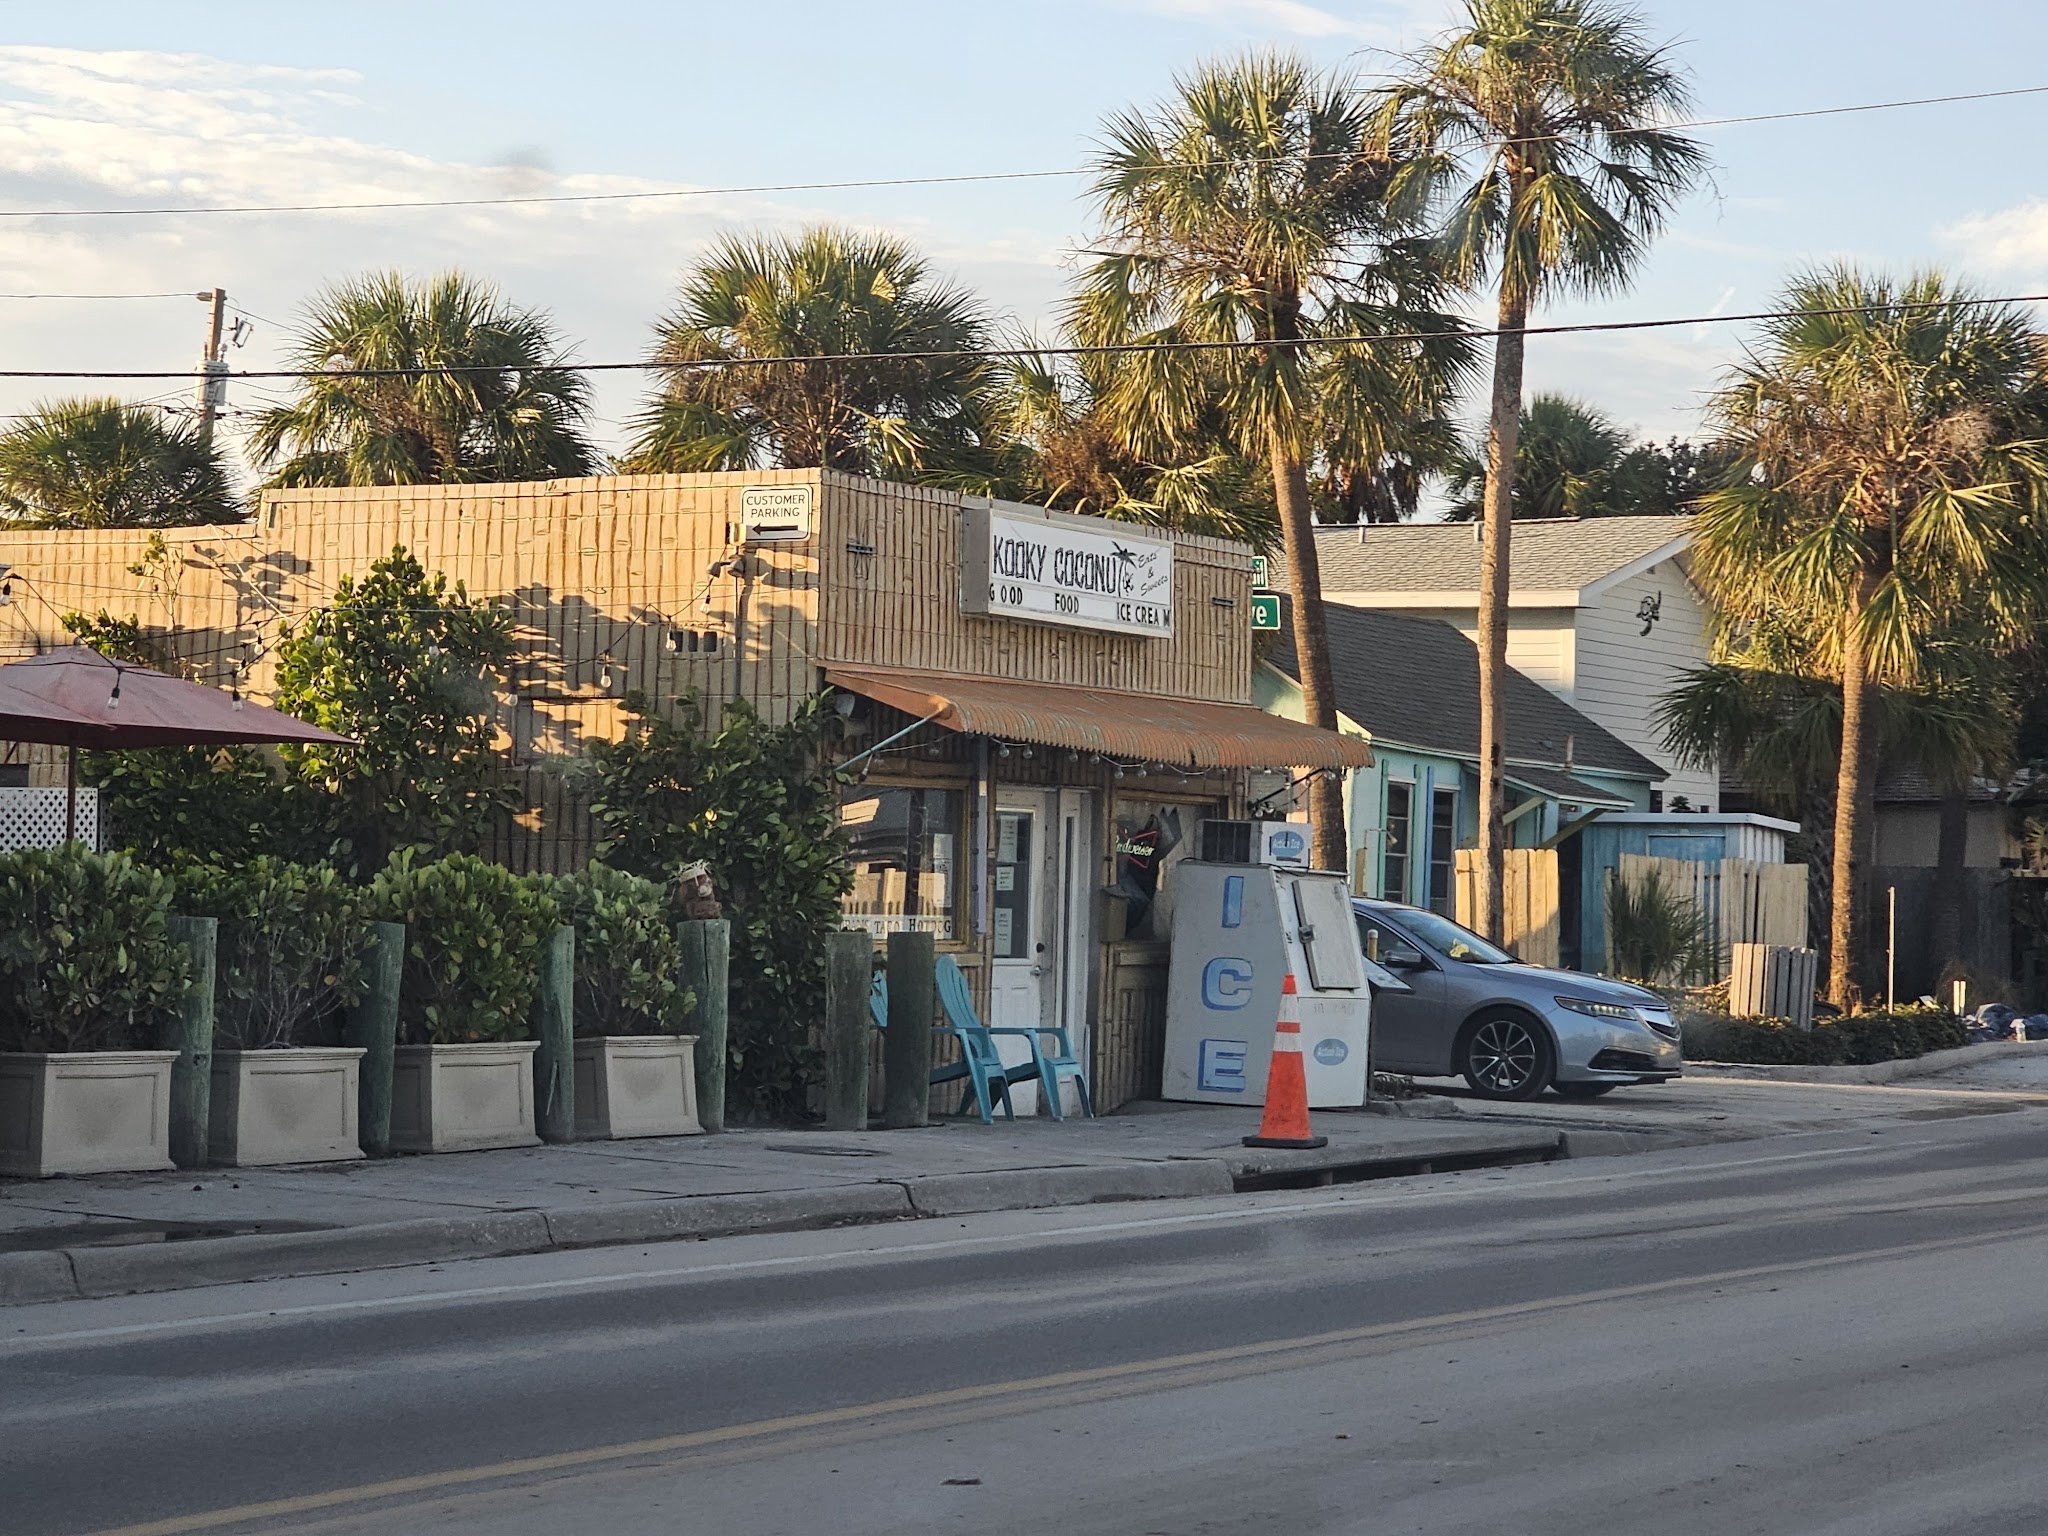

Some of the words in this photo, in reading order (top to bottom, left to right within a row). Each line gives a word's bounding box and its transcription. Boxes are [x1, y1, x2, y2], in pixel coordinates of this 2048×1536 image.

[746, 494, 805, 506] CUSTOMER
[751, 507, 800, 518] PARKING
[993, 534, 1047, 582] KOOKY
[1055, 593, 1080, 614] FOOD
[1116, 601, 1131, 622] ICE
[1197, 875, 1254, 1093] ICE
